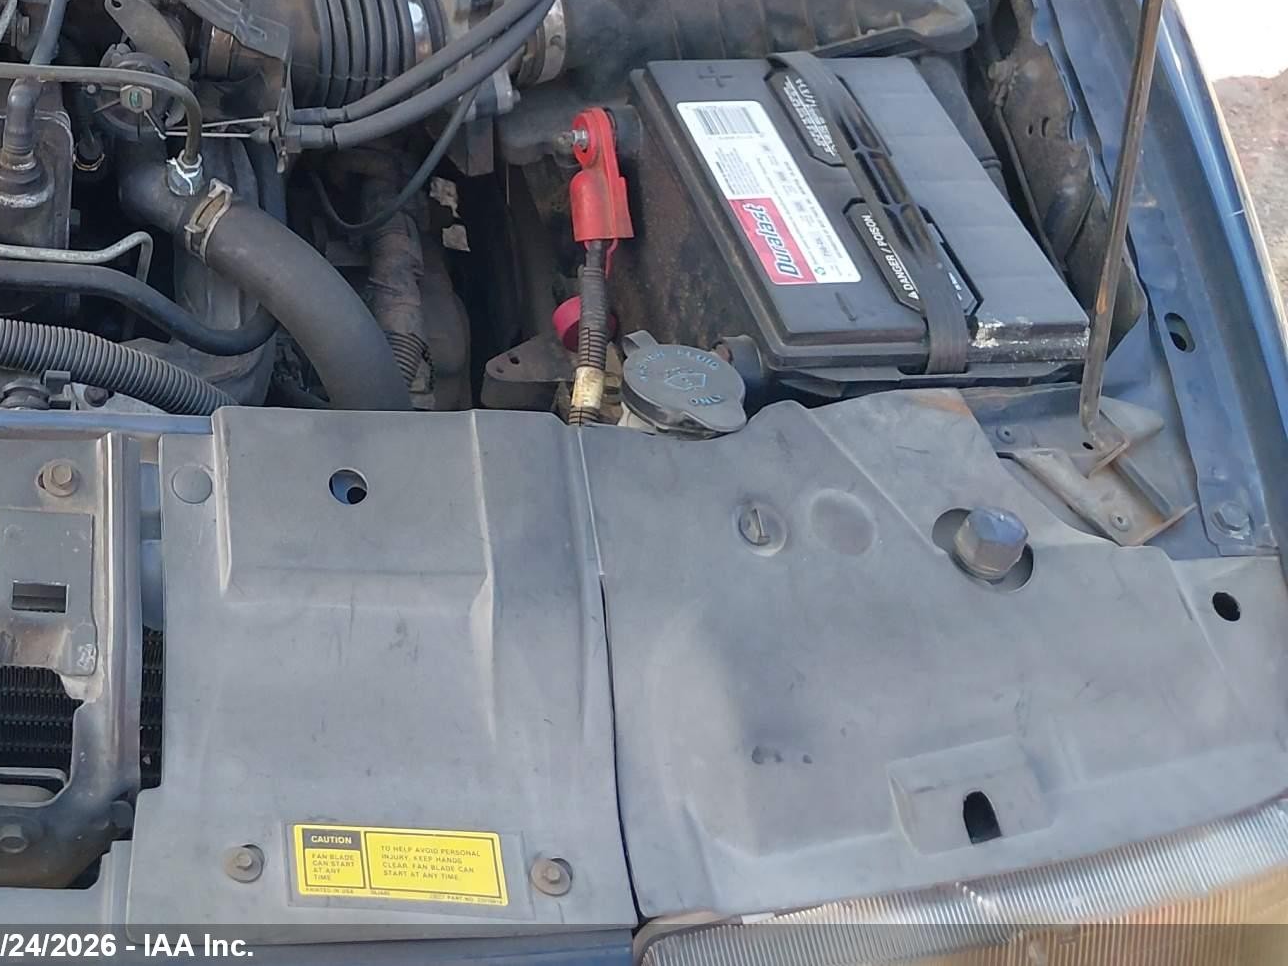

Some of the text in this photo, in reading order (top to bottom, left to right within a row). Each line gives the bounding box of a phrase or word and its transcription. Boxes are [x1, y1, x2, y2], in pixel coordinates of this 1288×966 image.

[742, 202, 805, 279] Duralast
[861, 215, 888, 247] POISON
[885, 255, 914, 291] DANGER
[311, 835, 352, 844] CAUTION
[393, 845, 413, 853] HELP
[440, 848, 481, 857] PERSONAL
